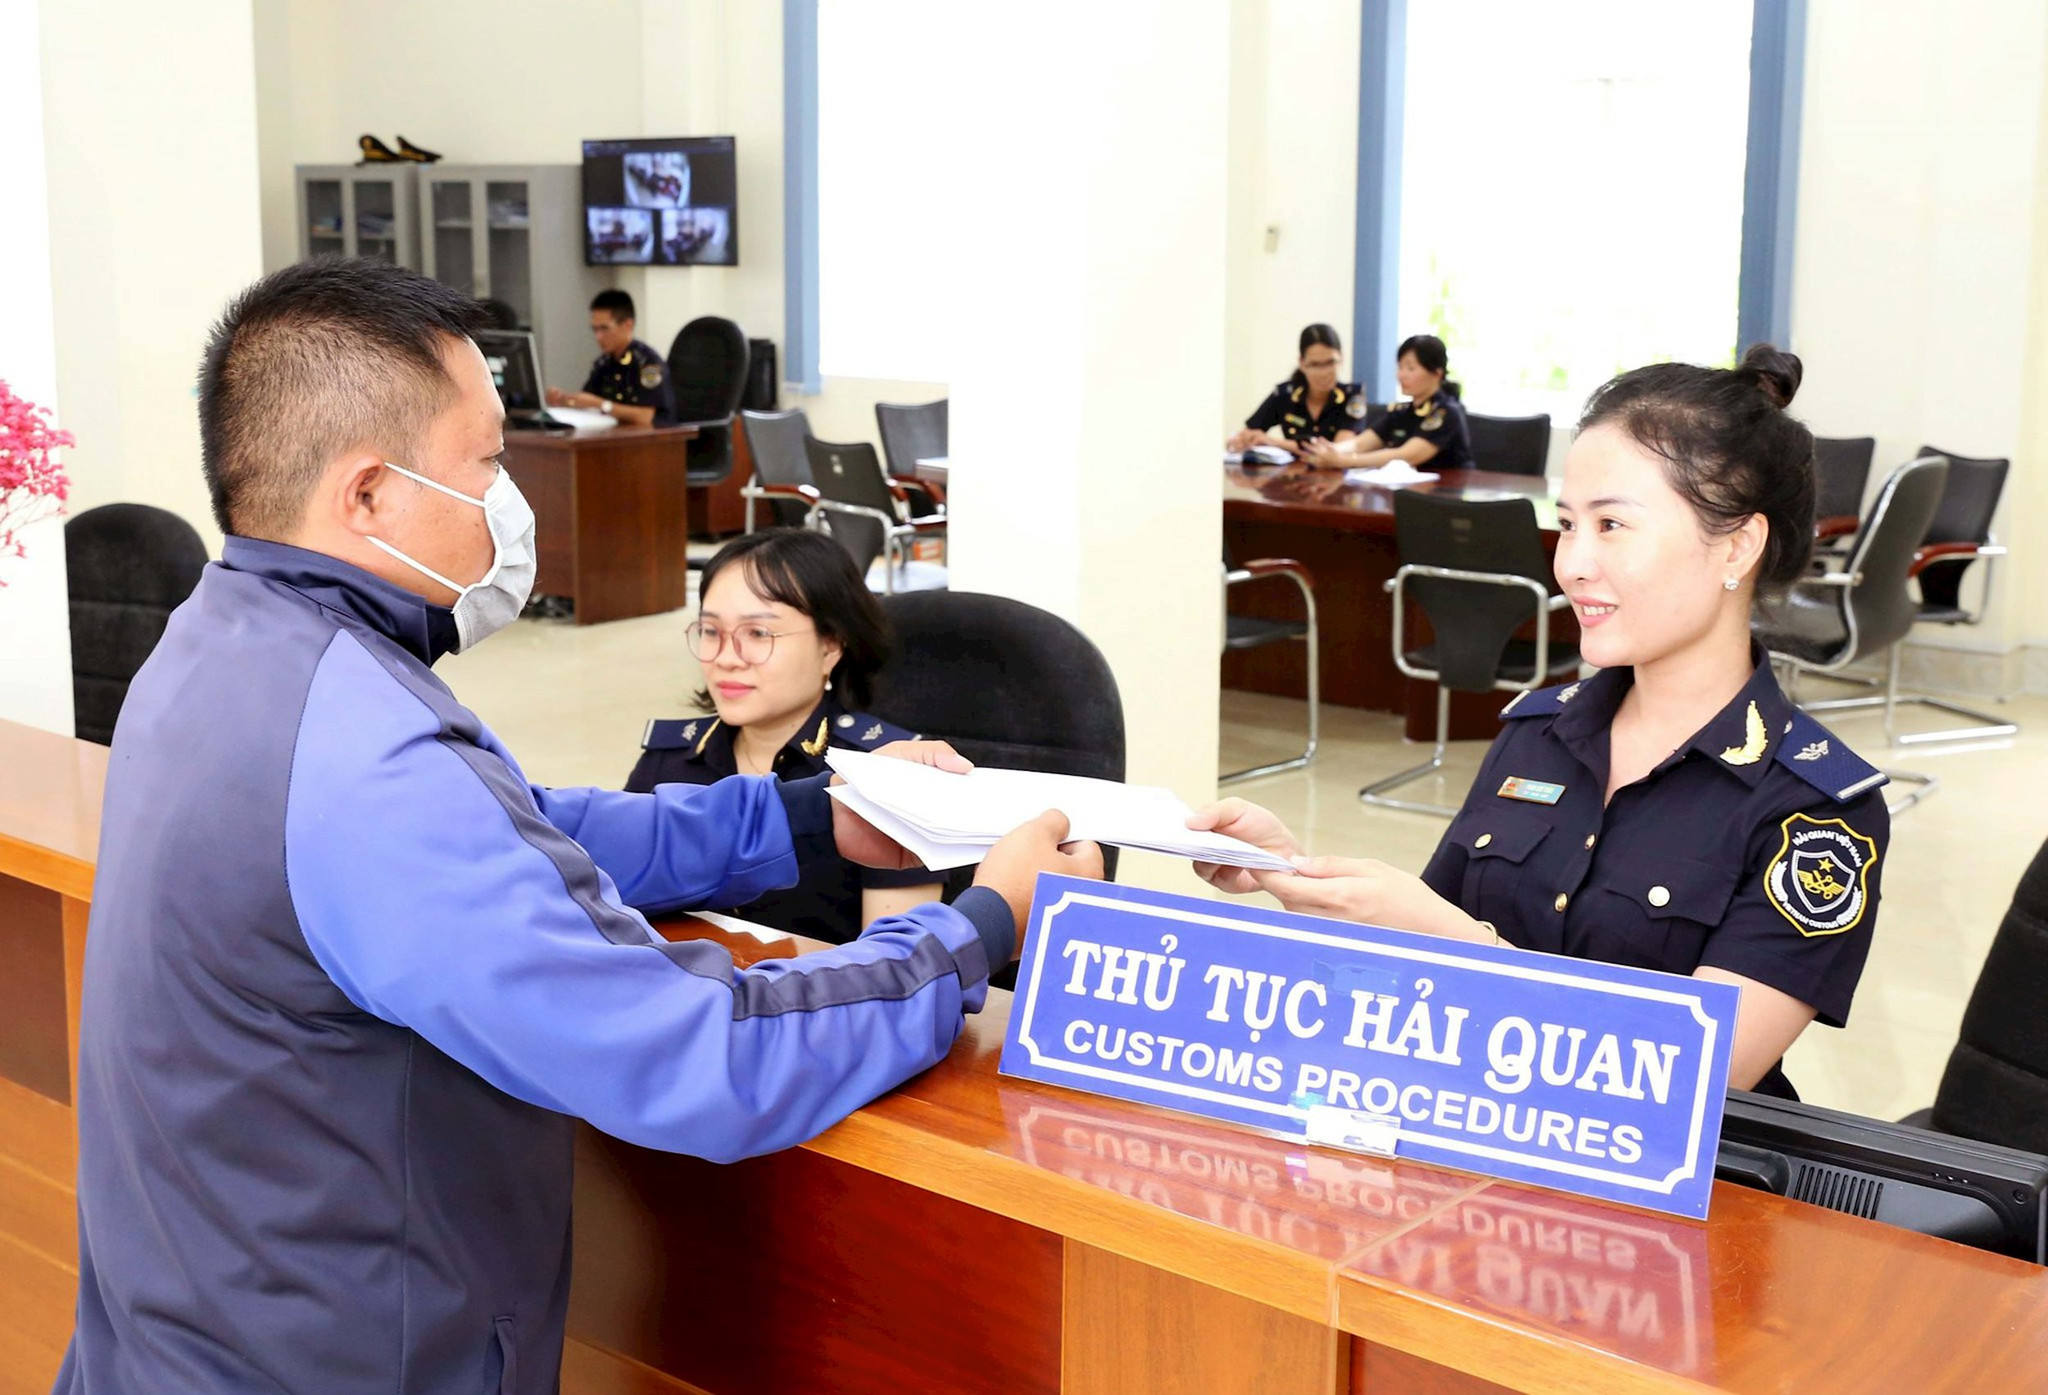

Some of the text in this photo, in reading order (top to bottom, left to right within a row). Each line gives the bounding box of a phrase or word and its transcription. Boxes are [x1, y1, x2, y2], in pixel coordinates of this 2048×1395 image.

[1808, 830, 1834, 840] QUAN
[1063, 935, 1680, 1104] THỦ TỤC HẢI QUAN
[1065, 1020, 1642, 1163] CUSTOMS PROCEDURES
